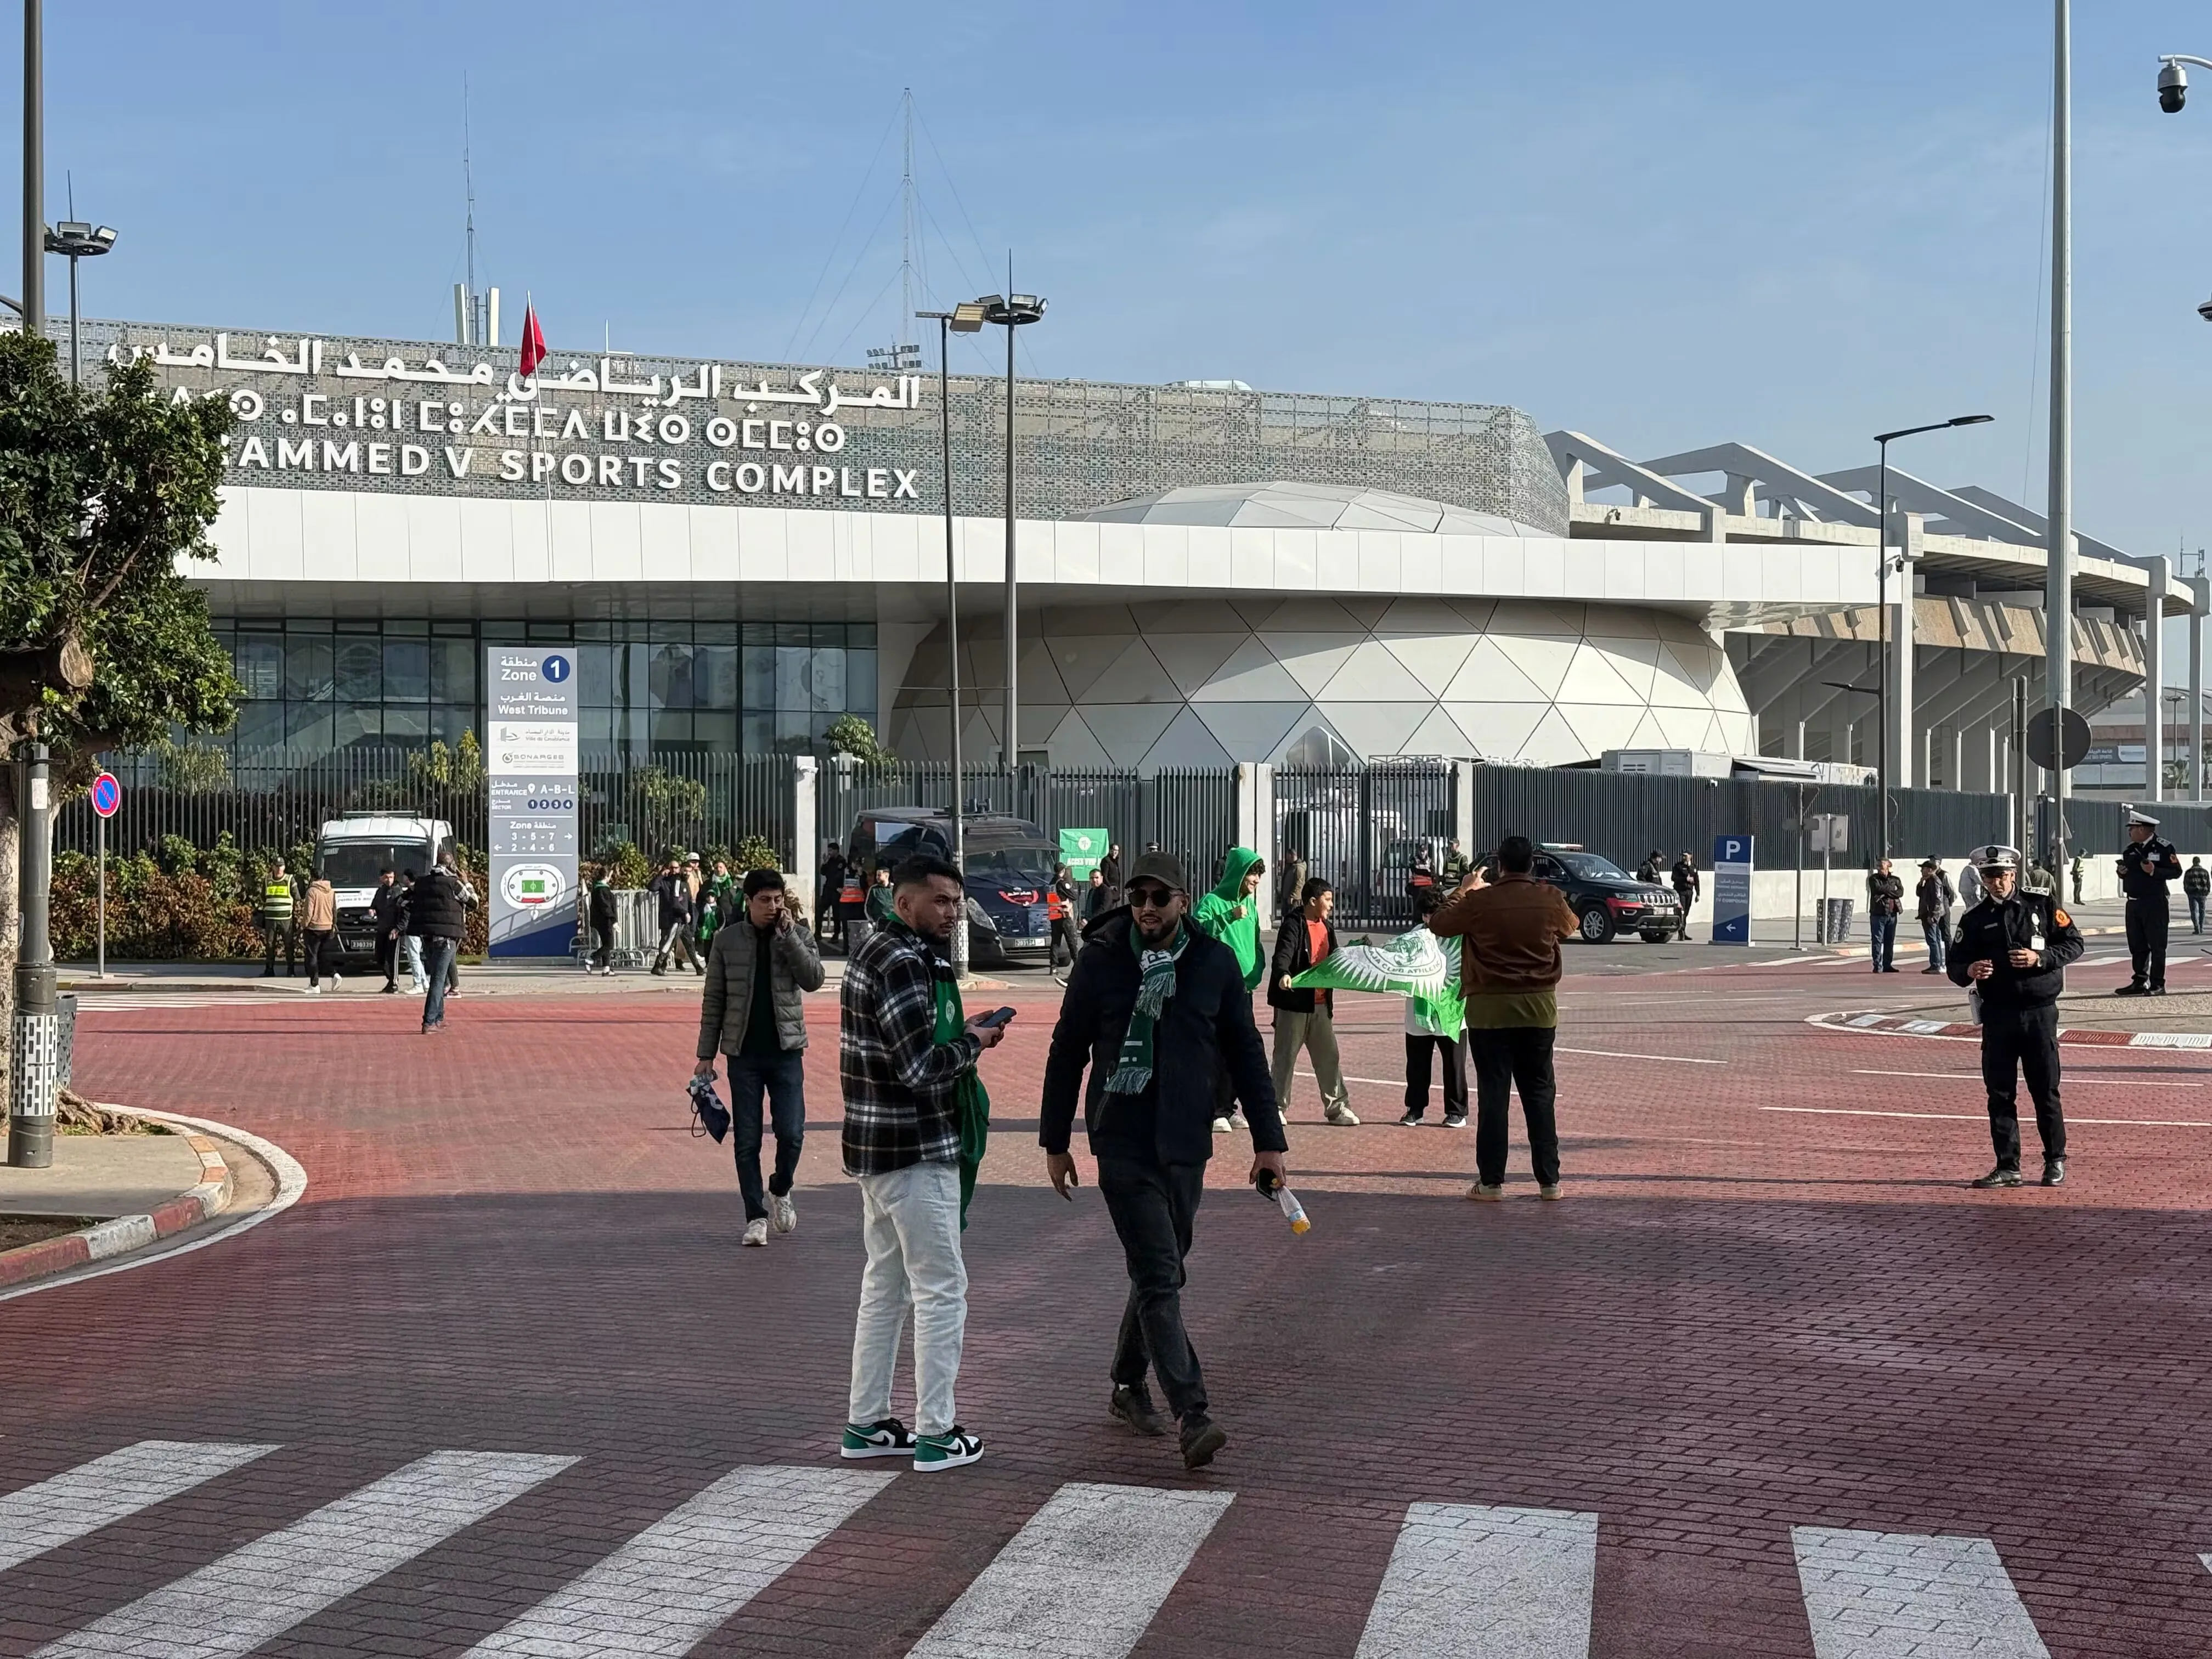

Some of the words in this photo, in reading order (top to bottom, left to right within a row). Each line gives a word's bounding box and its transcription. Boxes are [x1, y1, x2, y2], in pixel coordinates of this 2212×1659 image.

[108, 331, 323, 375] الخامس
[335, 351, 494, 386] محمد
[495, 357, 721, 408] الرياضي
[733, 368, 921, 416] المركب
[221, 433, 430, 476] AMMED
[444, 446, 474, 478] V
[500, 449, 682, 490] SPORTS
[707, 460, 918, 499] COMPLEX
[500, 656, 538, 667] منطقة
[501, 669, 537, 681] Zone
[550, 659, 560, 679] 1
[500, 692, 532, 703] الغرب
[534, 692, 566, 702] منصة
[498, 704, 526, 714] West
[528, 704, 568, 715] Tribune
[491, 780, 518, 788] مدخل
[510, 821, 532, 830] Zone
[511, 832, 518, 841] 3
[531, 832, 537, 841] 5
[549, 832, 555, 841] 7
[511, 843, 518, 852] 2
[529, 843, 537, 852] 4
[549, 843, 555, 852] 6
[1726, 840, 1741, 860] P
[1369, 950, 1381, 964] AJA
